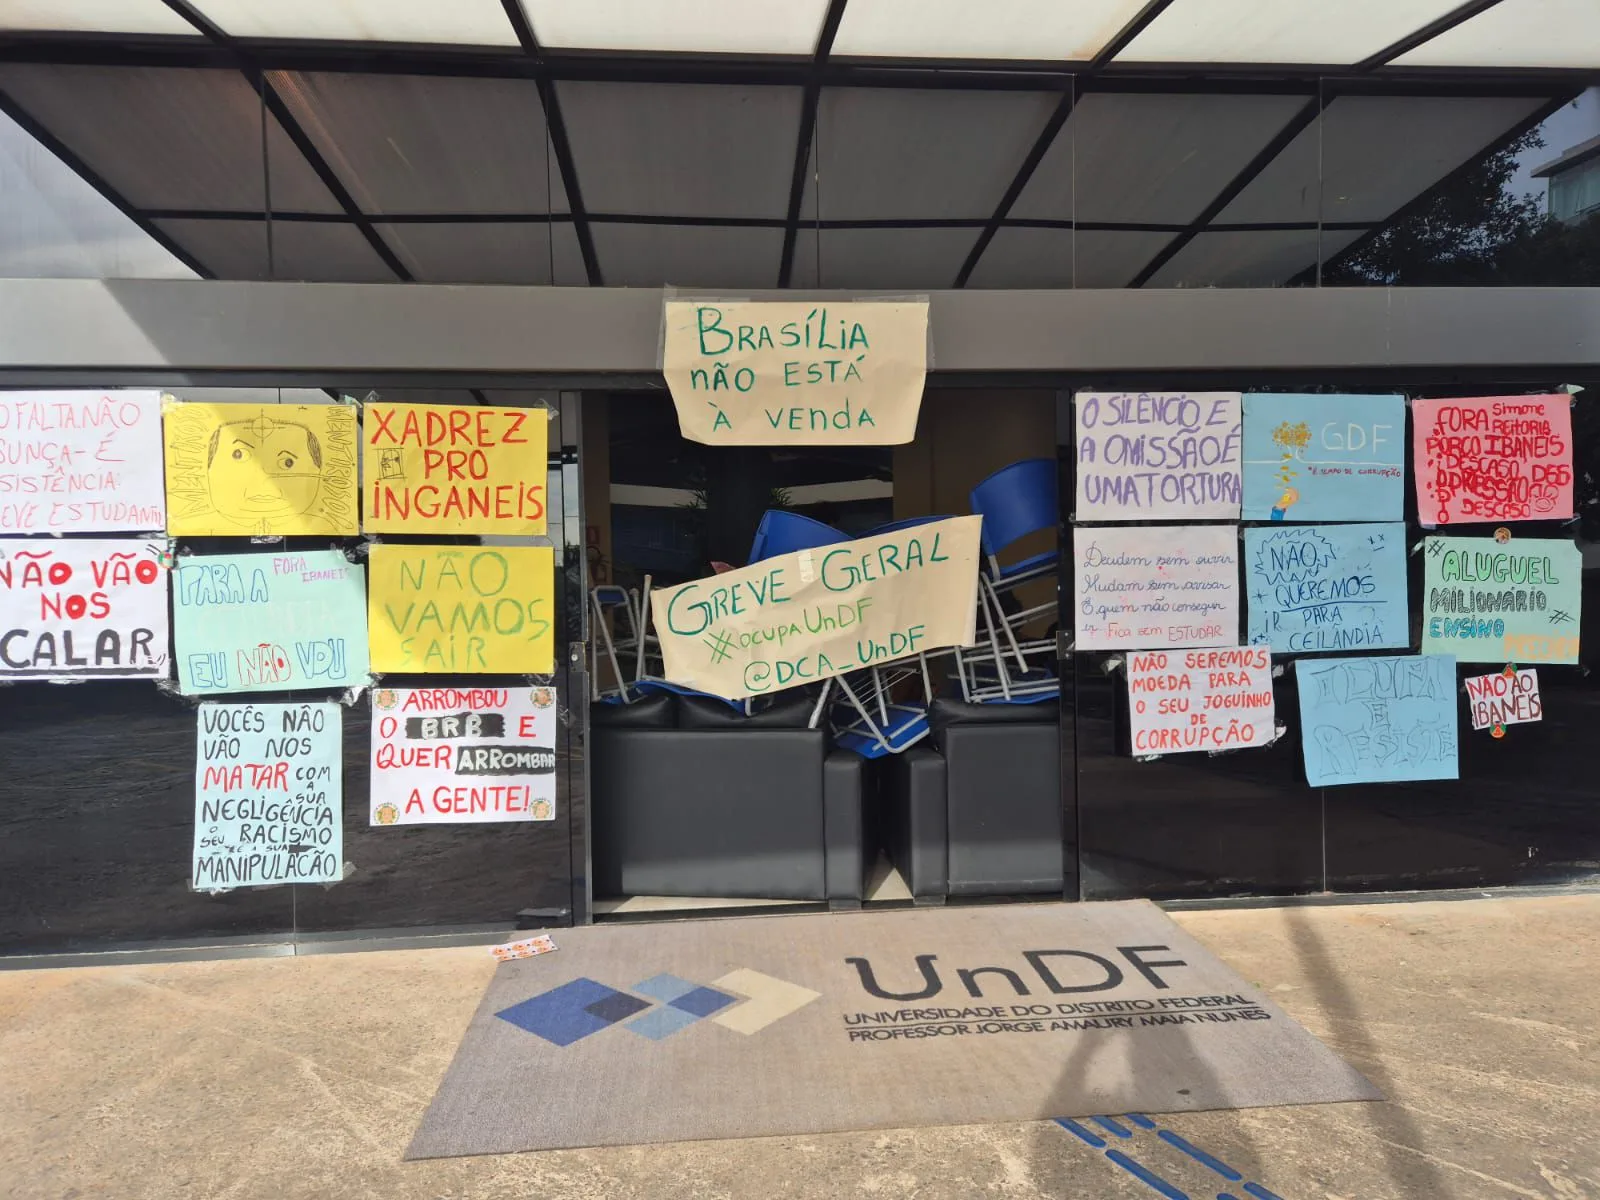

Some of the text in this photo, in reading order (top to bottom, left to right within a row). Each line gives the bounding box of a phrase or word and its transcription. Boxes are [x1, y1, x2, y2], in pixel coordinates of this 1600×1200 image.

[784, 354, 866, 387] ESTÁ
[707, 401, 732, 432] À
[1081, 393, 1230, 429] O SILÊNCIO E
[1434, 406, 1490, 436] FORA
[370, 409, 529, 448] XADREZ
[1080, 436, 1096, 463] A
[1220, 424, 1241, 464] É
[1321, 422, 1393, 453] GDF
[94, 429, 126, 462] É
[1484, 434, 1565, 464] IBANEIS
[424, 449, 489, 481] PRO
[1085, 471, 1242, 507] UMA TORTURA
[91, 552, 158, 588] VÃO
[1270, 541, 1318, 572] NÃO
[180, 563, 269, 606] PARA A
[400, 551, 508, 597] NÃO
[668, 532, 950, 636] GREVE GERAL
[41, 592, 110, 621] NOS
[1275, 574, 1377, 609] QUEREMOS
[385, 597, 550, 642] VAMOS
[1168, 623, 1225, 642] ESTUDAR
[1303, 605, 1344, 629] PARA
[1429, 614, 1505, 639] ENSINO
[0, 628, 154, 668] CALAR
[188, 638, 347, 688] EU NÃO VOU
[1133, 649, 1268, 673] NÃO SEREMOS
[1132, 671, 1251, 694] MOEDA PARA
[1466, 674, 1534, 700] NÃO AO
[402, 689, 509, 712] ARROMBOU
[1135, 691, 1272, 715] O SEU JOGUINHO
[203, 705, 325, 734] VOCÊS NÃO
[379, 714, 537, 741] O BRB E
[1135, 719, 1255, 750] CORRUPÇÃO
[1190, 714, 1207, 726] DE
[203, 734, 312, 760] VÃO NOS
[376, 743, 556, 772] QUER ARROMBAR
[203, 761, 331, 793] MATAR COM
[202, 796, 334, 827] NEGLIGÊNCIA
[295, 791, 327, 805] SUA
[405, 788, 425, 814] A
[432, 785, 530, 814] GENTE!
[200, 823, 333, 849] SEU RACISMO
[844, 944, 1188, 1001] UnDF
[843, 994, 1256, 1025] UNIVERSIDADE DO DISTRITO FEDERAL
[848, 1005, 1272, 1042] PROFESSOR JORGE AMAURY MAIA NUNES
